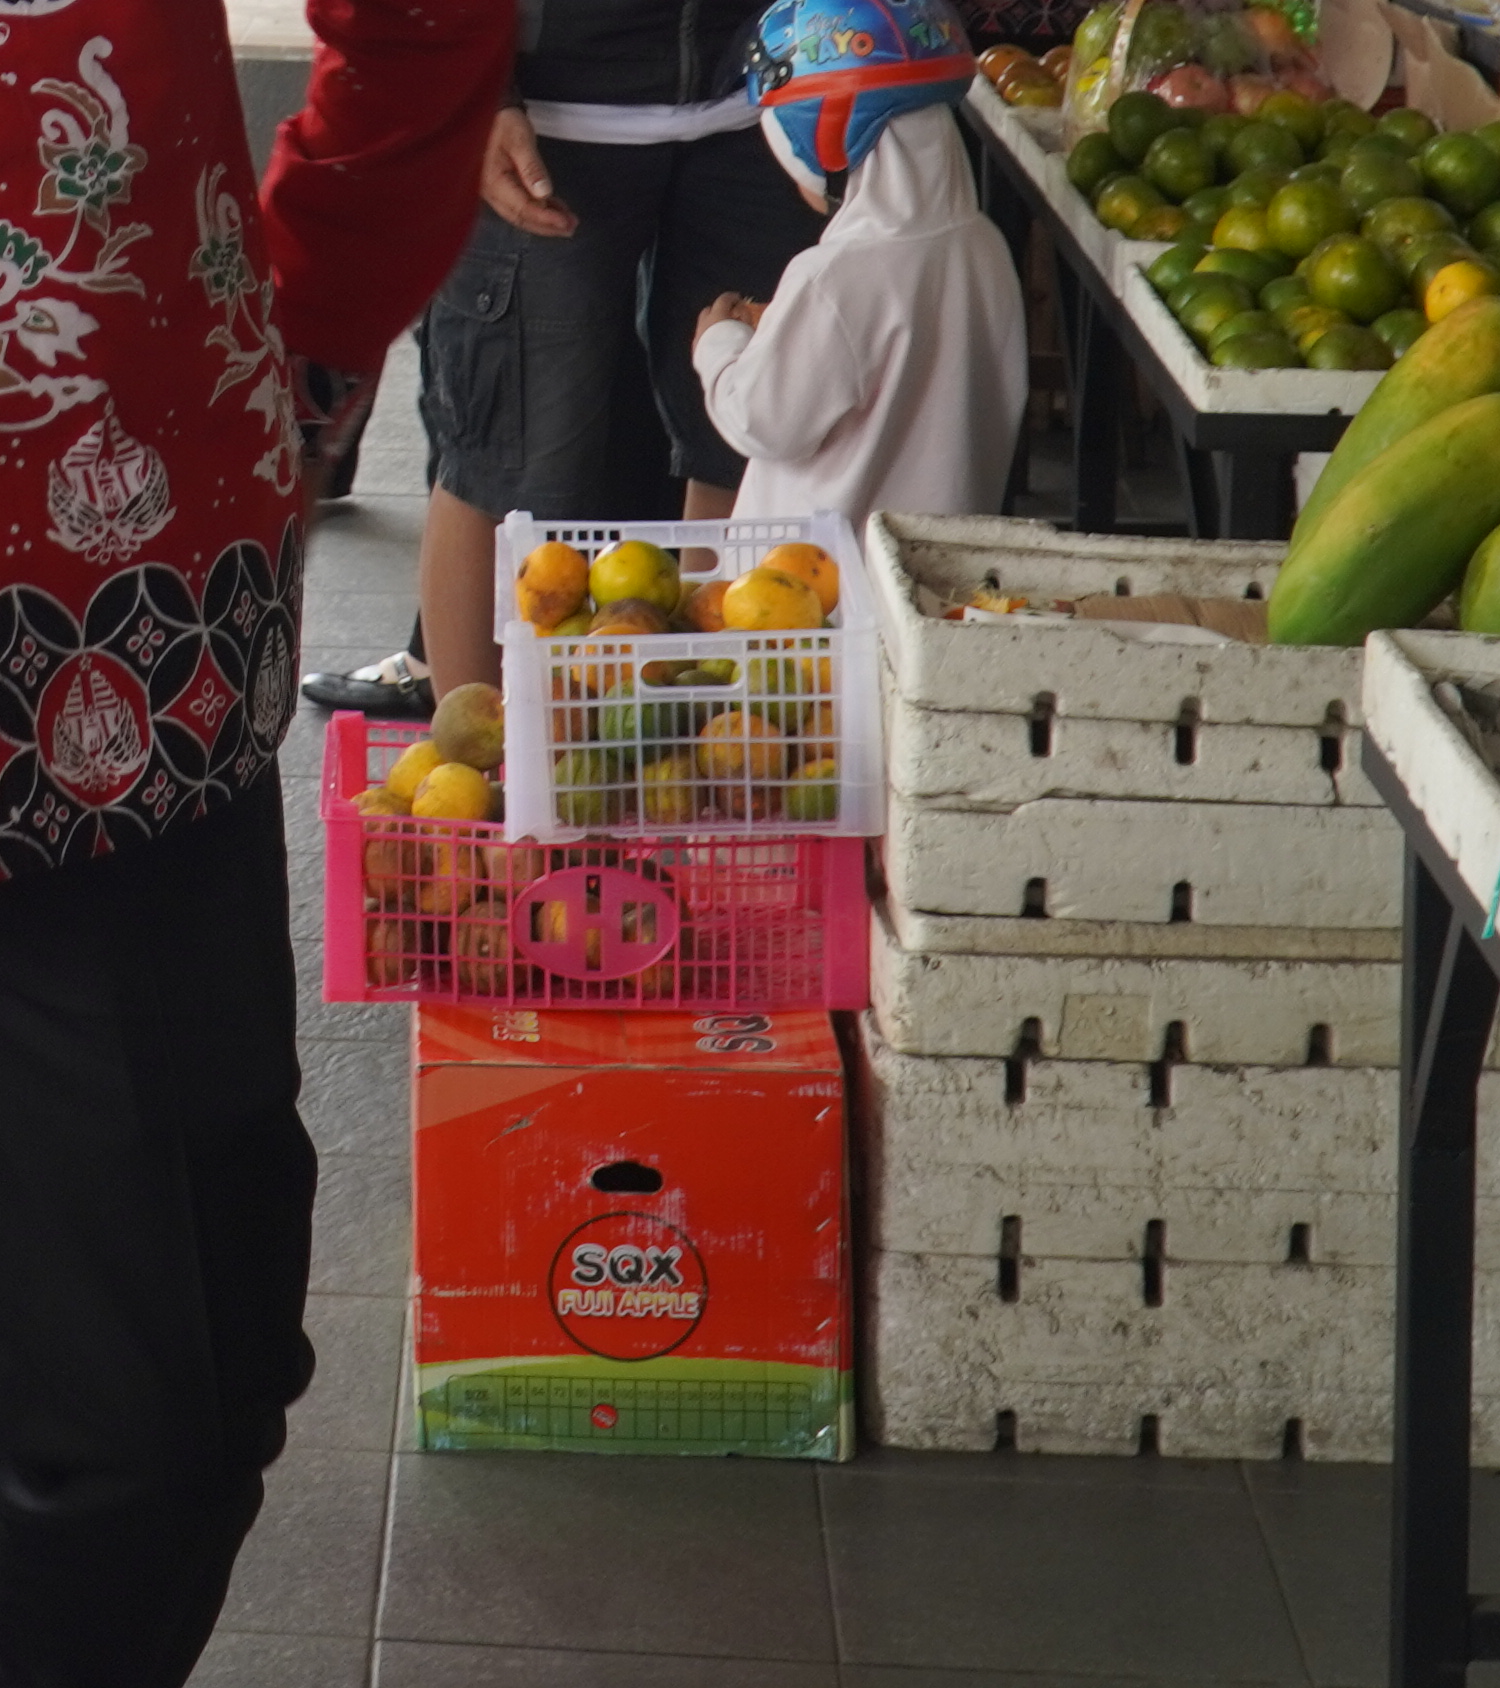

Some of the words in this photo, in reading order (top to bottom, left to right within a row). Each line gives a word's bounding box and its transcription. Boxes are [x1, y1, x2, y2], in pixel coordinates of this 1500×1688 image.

[800, 28, 875, 65] TAYO
[571, 1243, 685, 1287] SQX
[557, 1289, 614, 1317] FUJI
[616, 1290, 701, 1319] APPLE
